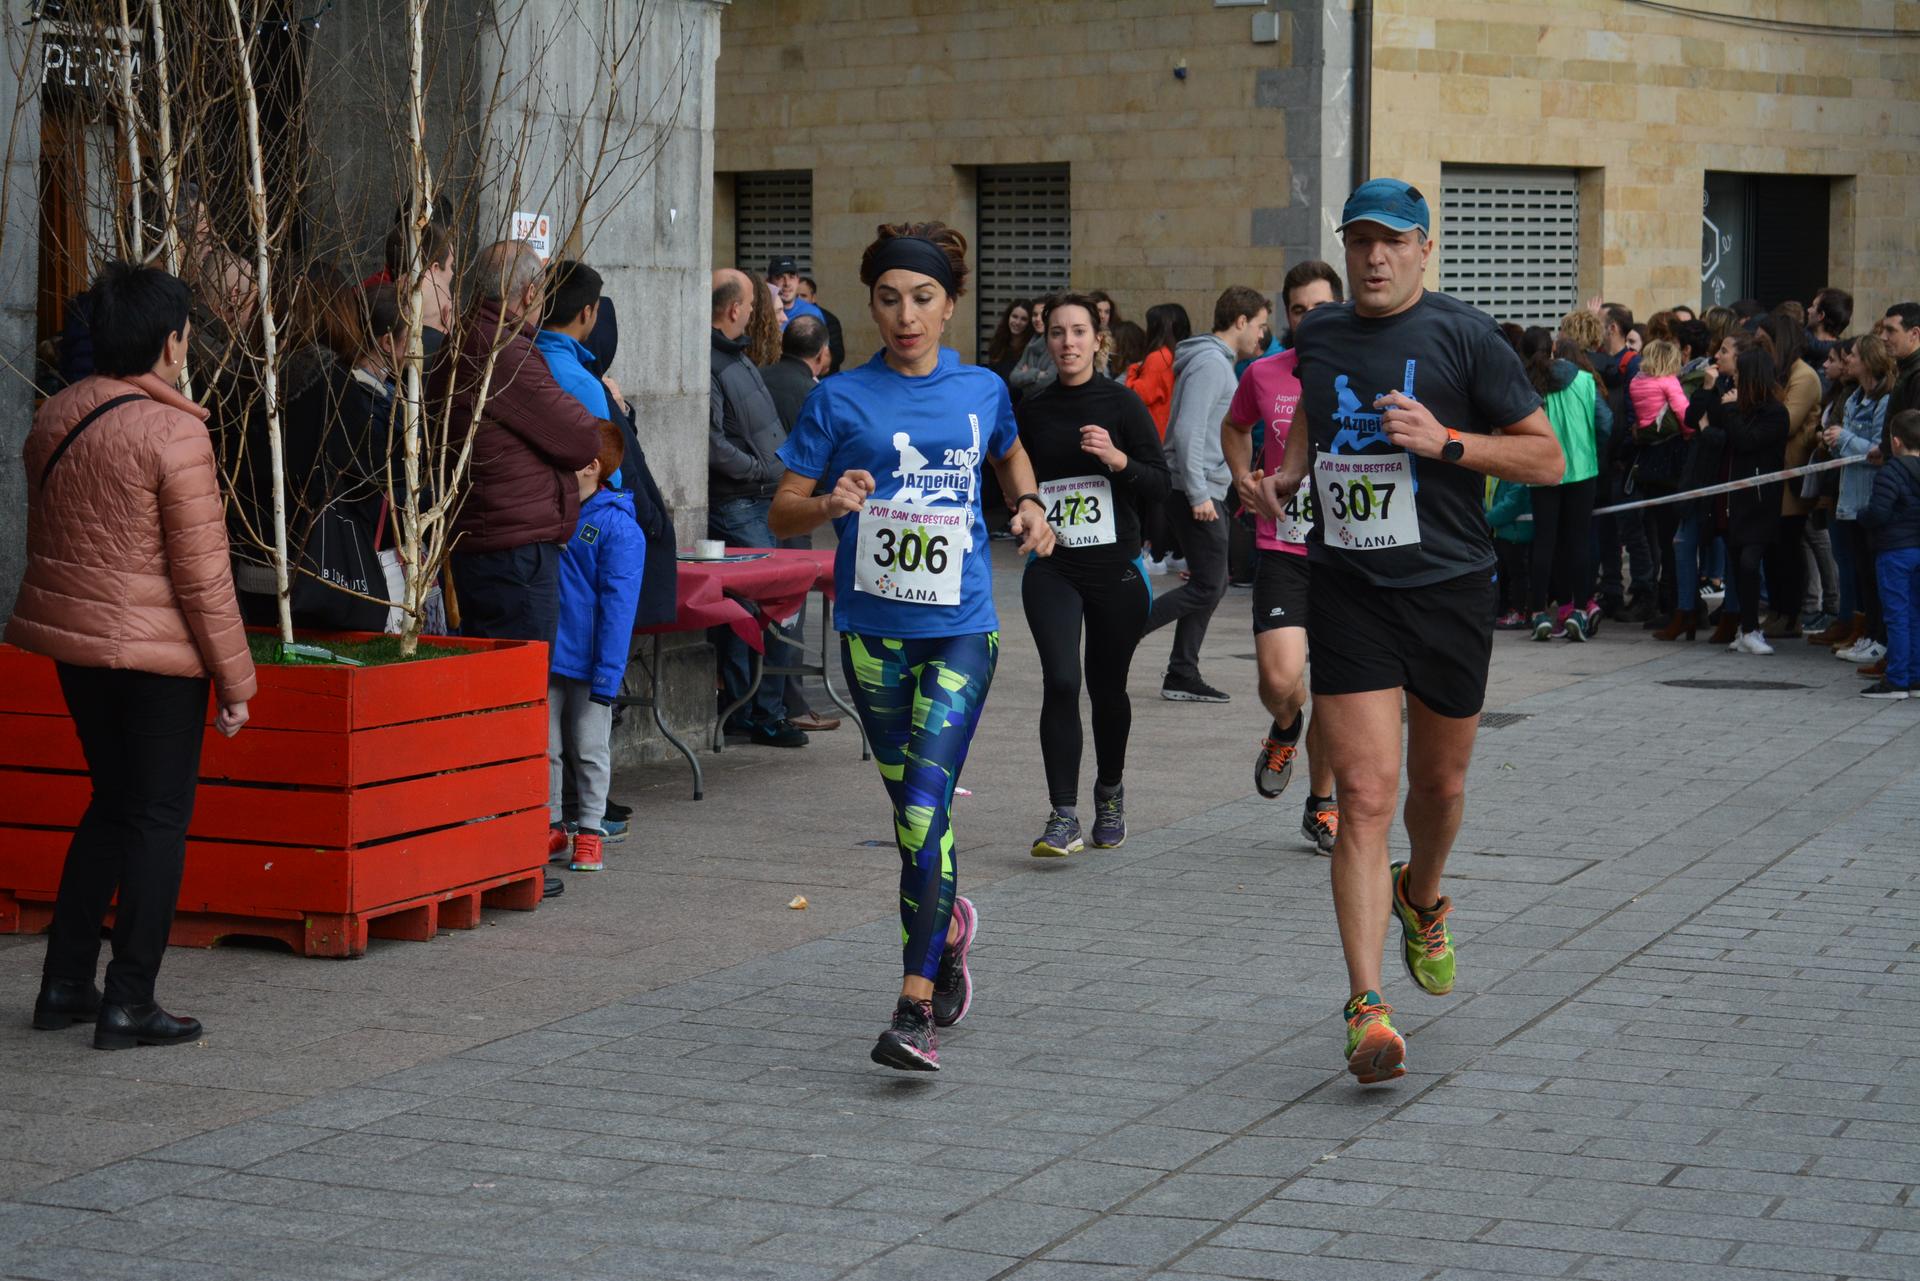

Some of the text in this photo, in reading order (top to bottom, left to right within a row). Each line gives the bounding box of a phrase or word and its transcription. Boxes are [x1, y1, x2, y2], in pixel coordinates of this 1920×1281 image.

[1343, 415, 1383, 434] Azpei
[943, 448, 979, 467] 2017
[1320, 460, 1403, 473] XVII SAN SILBESTREA
[905, 472, 969, 492] Azpeitia
[1043, 480, 1105, 495] XVII SAN SILBESTREA
[1046, 496, 1101, 526] 473
[1329, 482, 1396, 521] 307
[869, 505, 889, 518] XVII
[891, 509, 909, 521] SAN
[911, 513, 960, 526] SILBESTREA
[1069, 535, 1100, 545] LANA
[1355, 535, 1397, 548] LANA
[873, 528, 949, 574] 306
[895, 587, 938, 602] LANA
